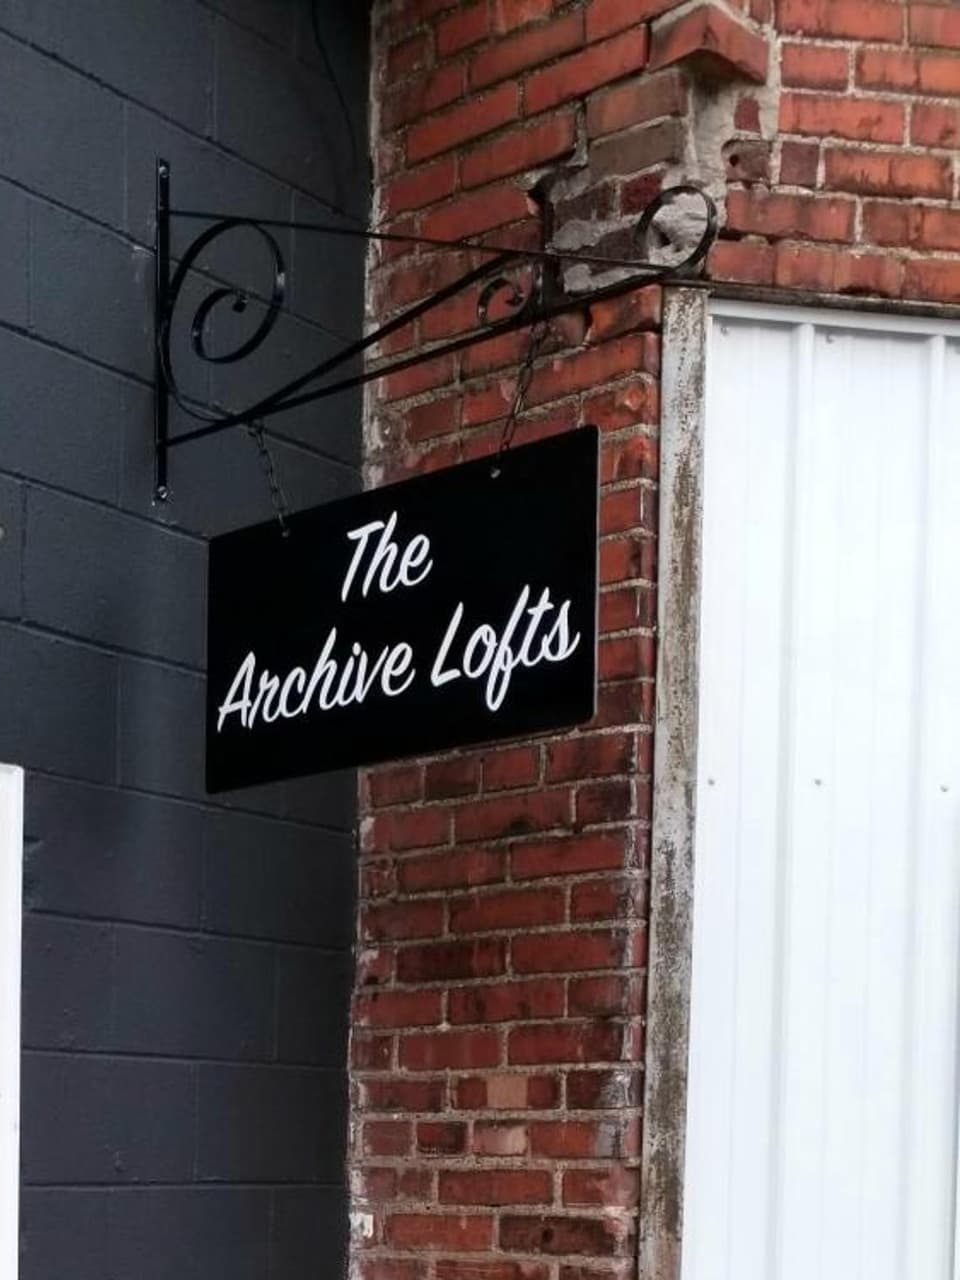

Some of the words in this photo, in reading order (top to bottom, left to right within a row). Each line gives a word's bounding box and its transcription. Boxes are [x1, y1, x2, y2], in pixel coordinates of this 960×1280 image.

[341, 510, 433, 602] The
[217, 627, 415, 732] Archive
[430, 584, 580, 712] Lofts
